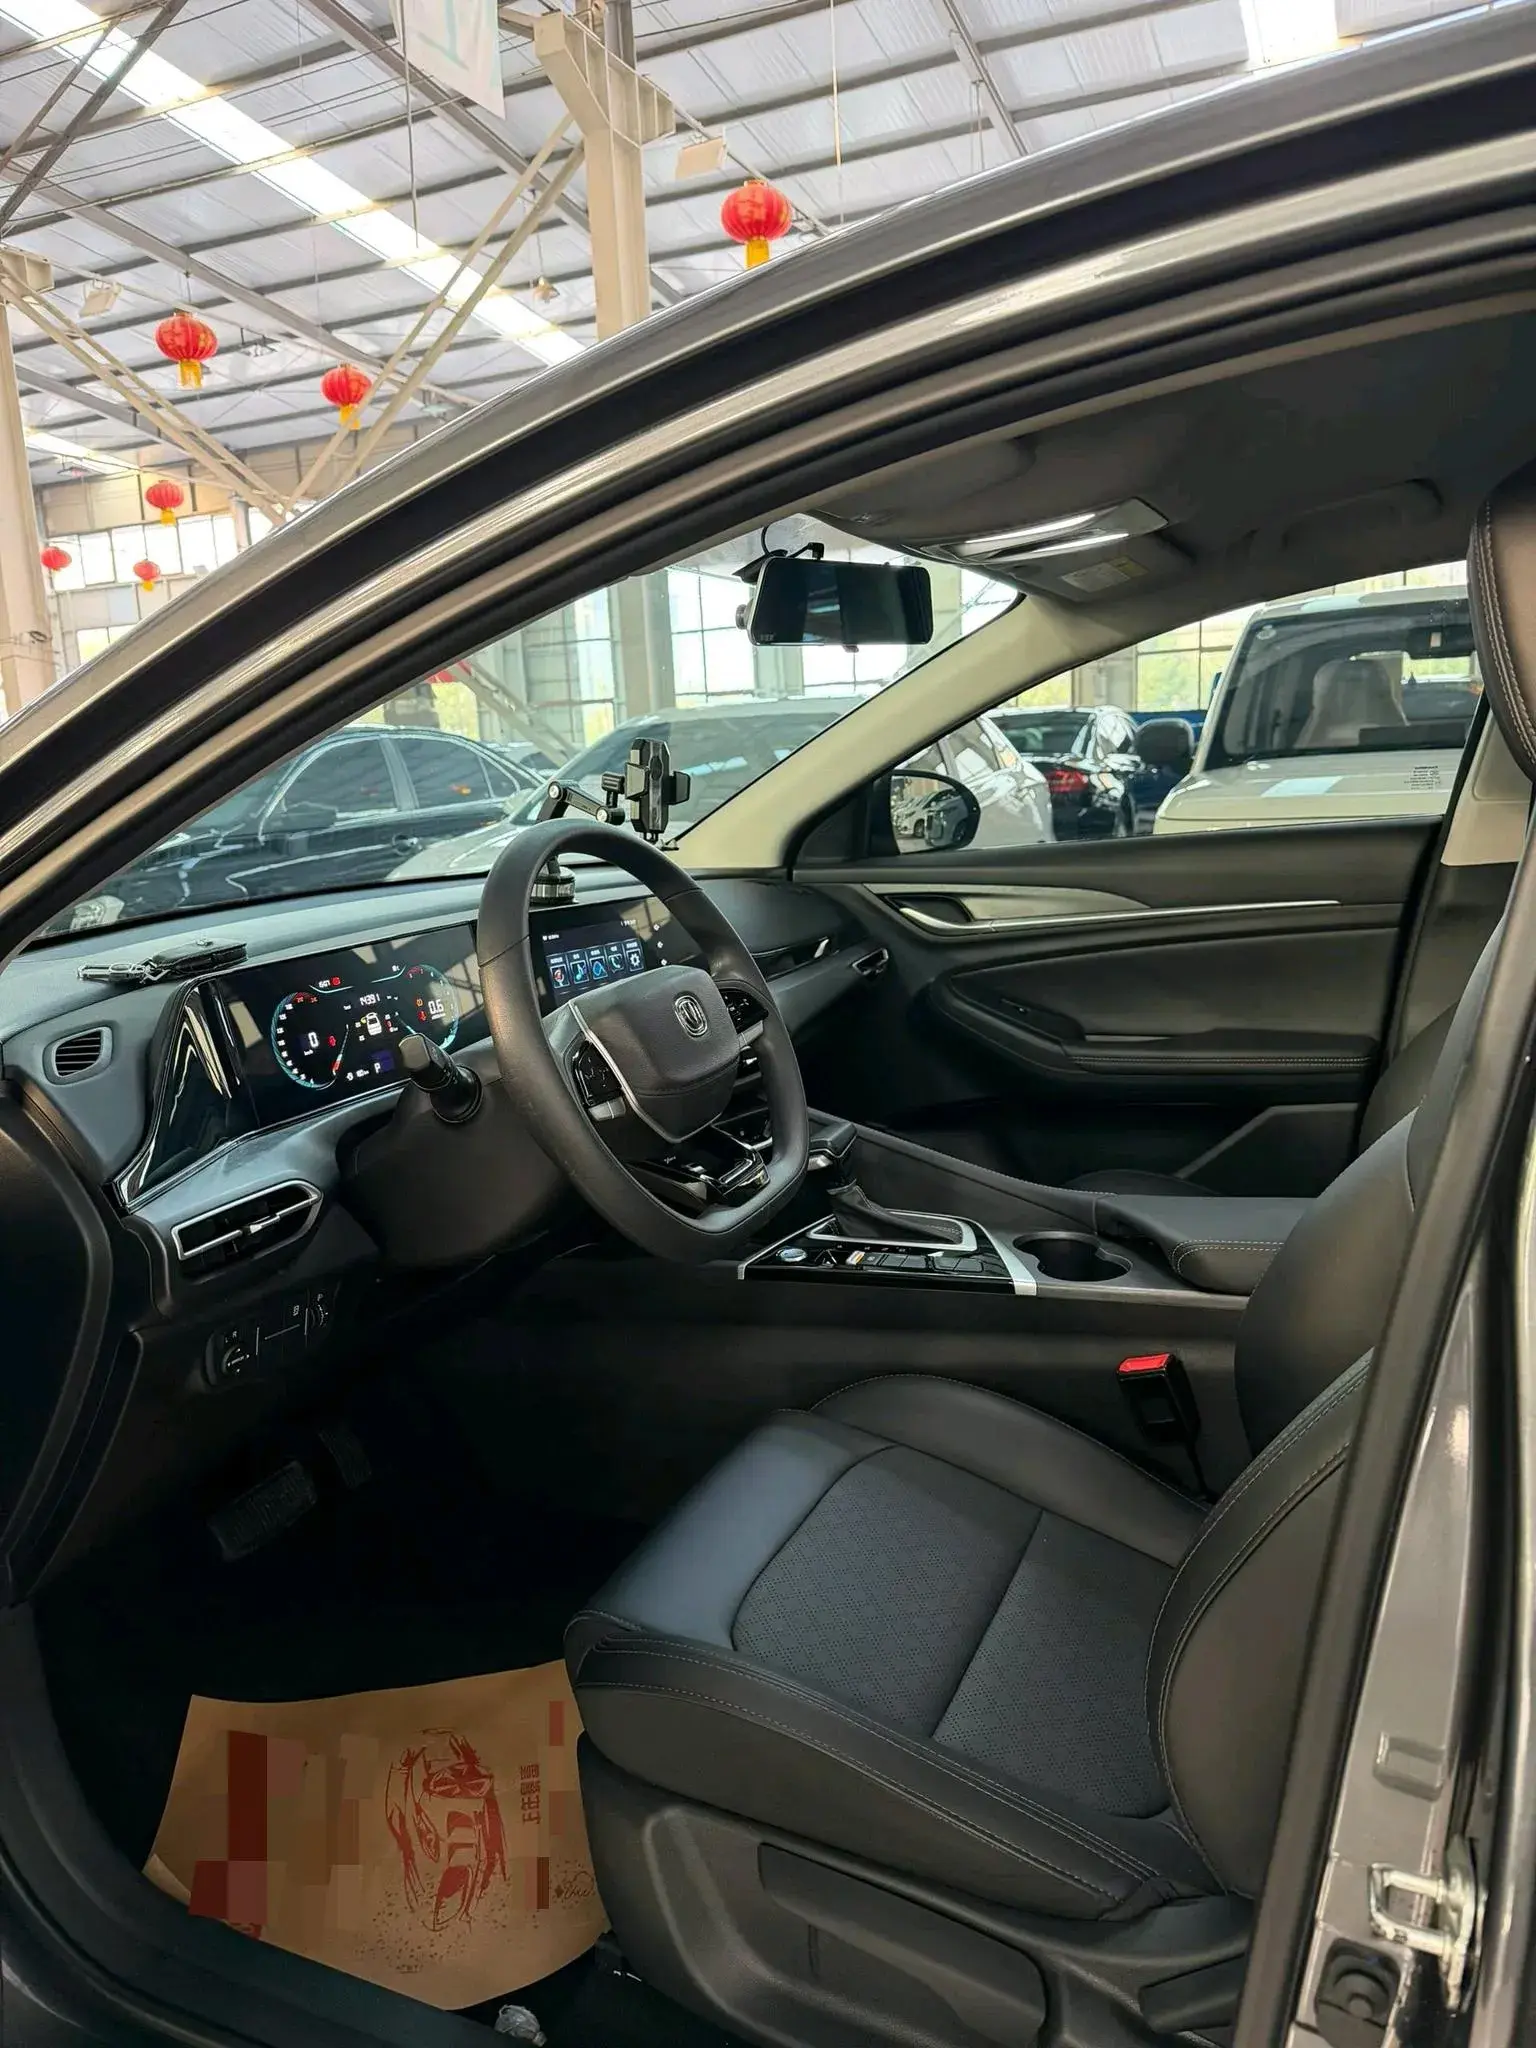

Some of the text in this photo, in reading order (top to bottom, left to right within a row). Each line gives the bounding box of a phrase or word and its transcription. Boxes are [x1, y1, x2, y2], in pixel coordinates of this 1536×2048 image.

[428, 998, 444, 1014] 0.6
[308, 1031, 319, 1048] 0
[374, 1062, 381, 1074] P
